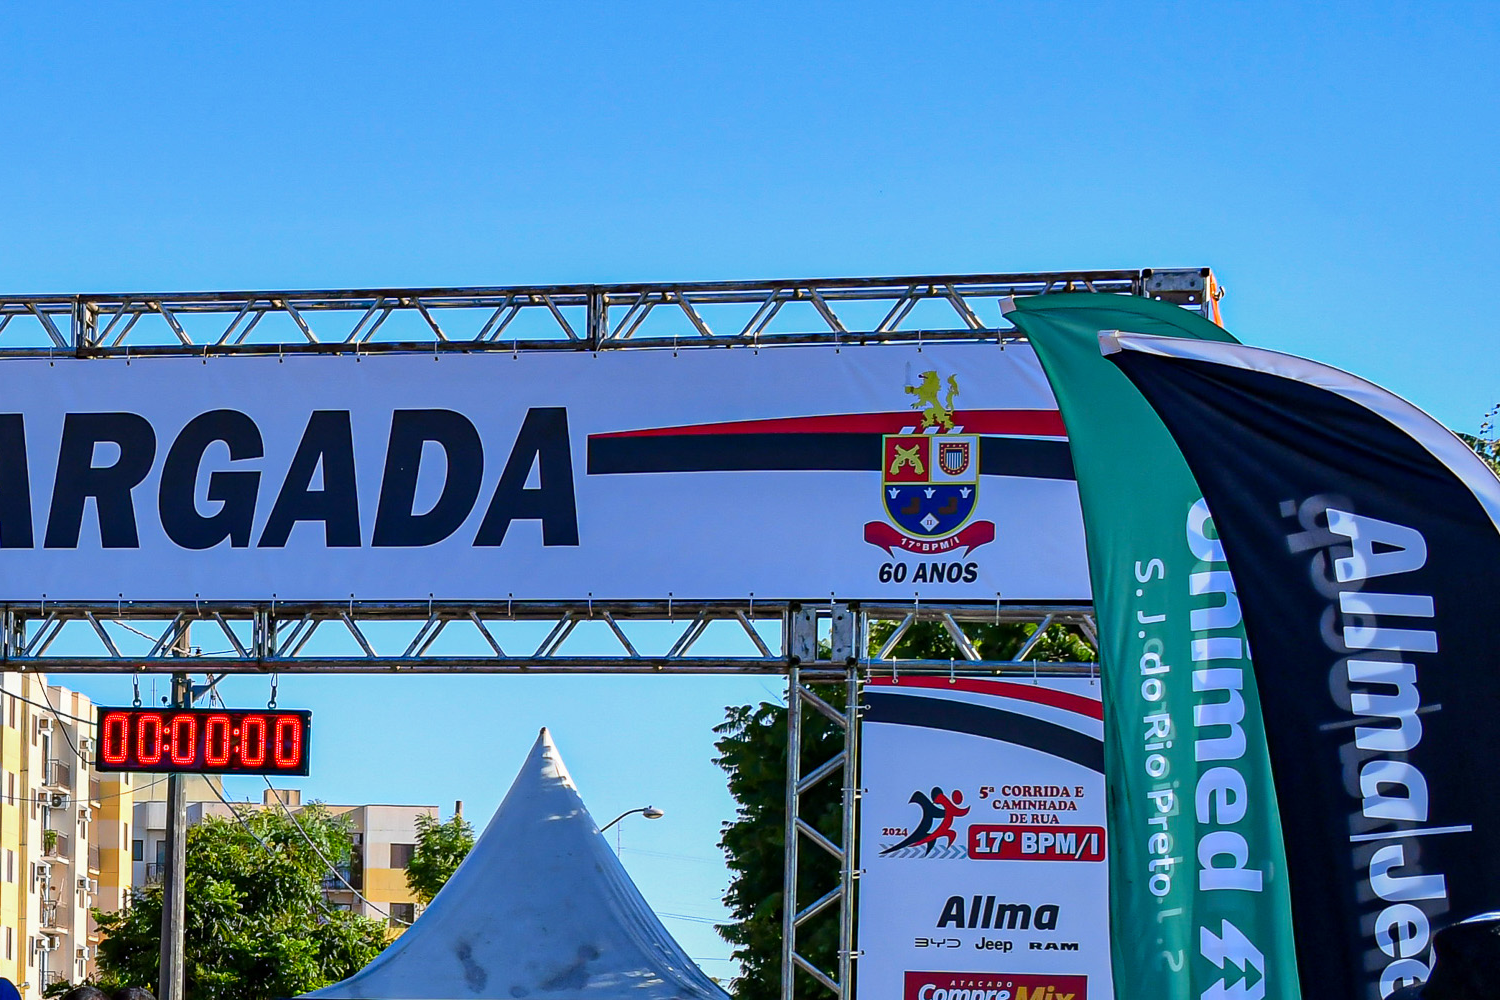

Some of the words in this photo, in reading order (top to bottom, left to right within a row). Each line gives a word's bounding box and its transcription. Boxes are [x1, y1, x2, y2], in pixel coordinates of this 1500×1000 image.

[878, 562, 908, 584] 60
[912, 562, 979, 584] ANOS
[1139, 652, 1171, 701] do
[104, 714, 300, 767] 00:00:00
[1142, 712, 1173, 778] Rio
[979, 786, 995, 799] 5ª
[1001, 785, 1071, 798] CORRIDA
[1074, 786, 1084, 798] E
[992, 799, 1077, 811] CAMINHADA
[1009, 813, 1028, 824] DE
[1030, 813, 1060, 824] RUA
[882, 828, 908, 837] 2024
[1147, 788, 1176, 897] Preto
[975, 832, 1014, 853] 17º
[1021, 833, 1100, 859] BPM/I
[936, 895, 1060, 931] Allma
[975, 937, 1013, 953] Jeep
[1029, 942, 1079, 951] RAM
